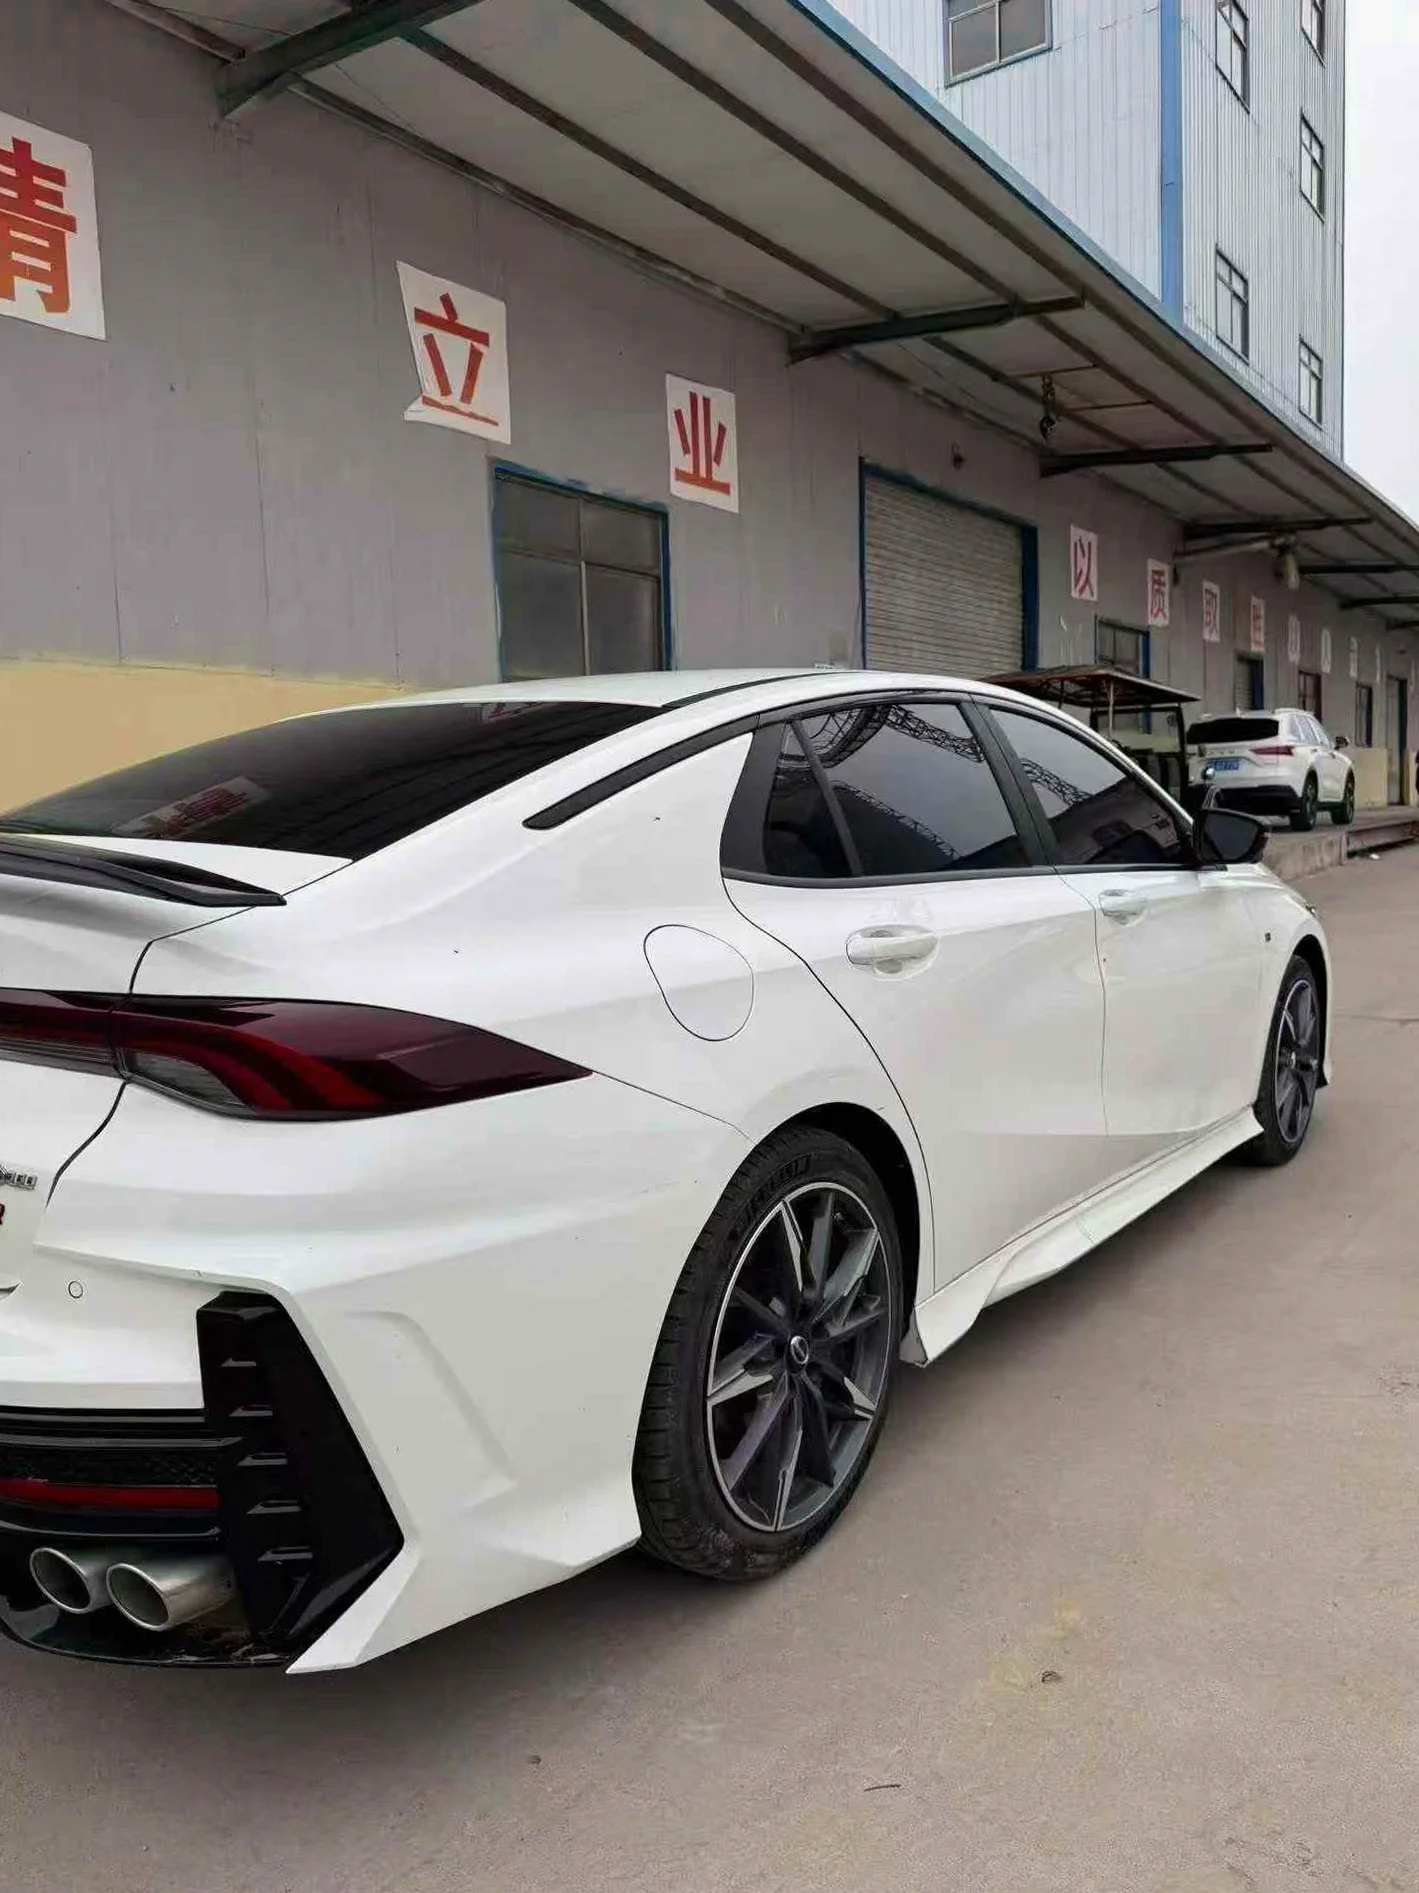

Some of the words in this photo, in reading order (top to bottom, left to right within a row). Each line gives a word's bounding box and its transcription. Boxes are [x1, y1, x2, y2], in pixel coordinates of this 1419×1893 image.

[414, 292, 499, 426] 立
[674, 391, 730, 495] 业
[1074, 536, 1094, 597] 以
